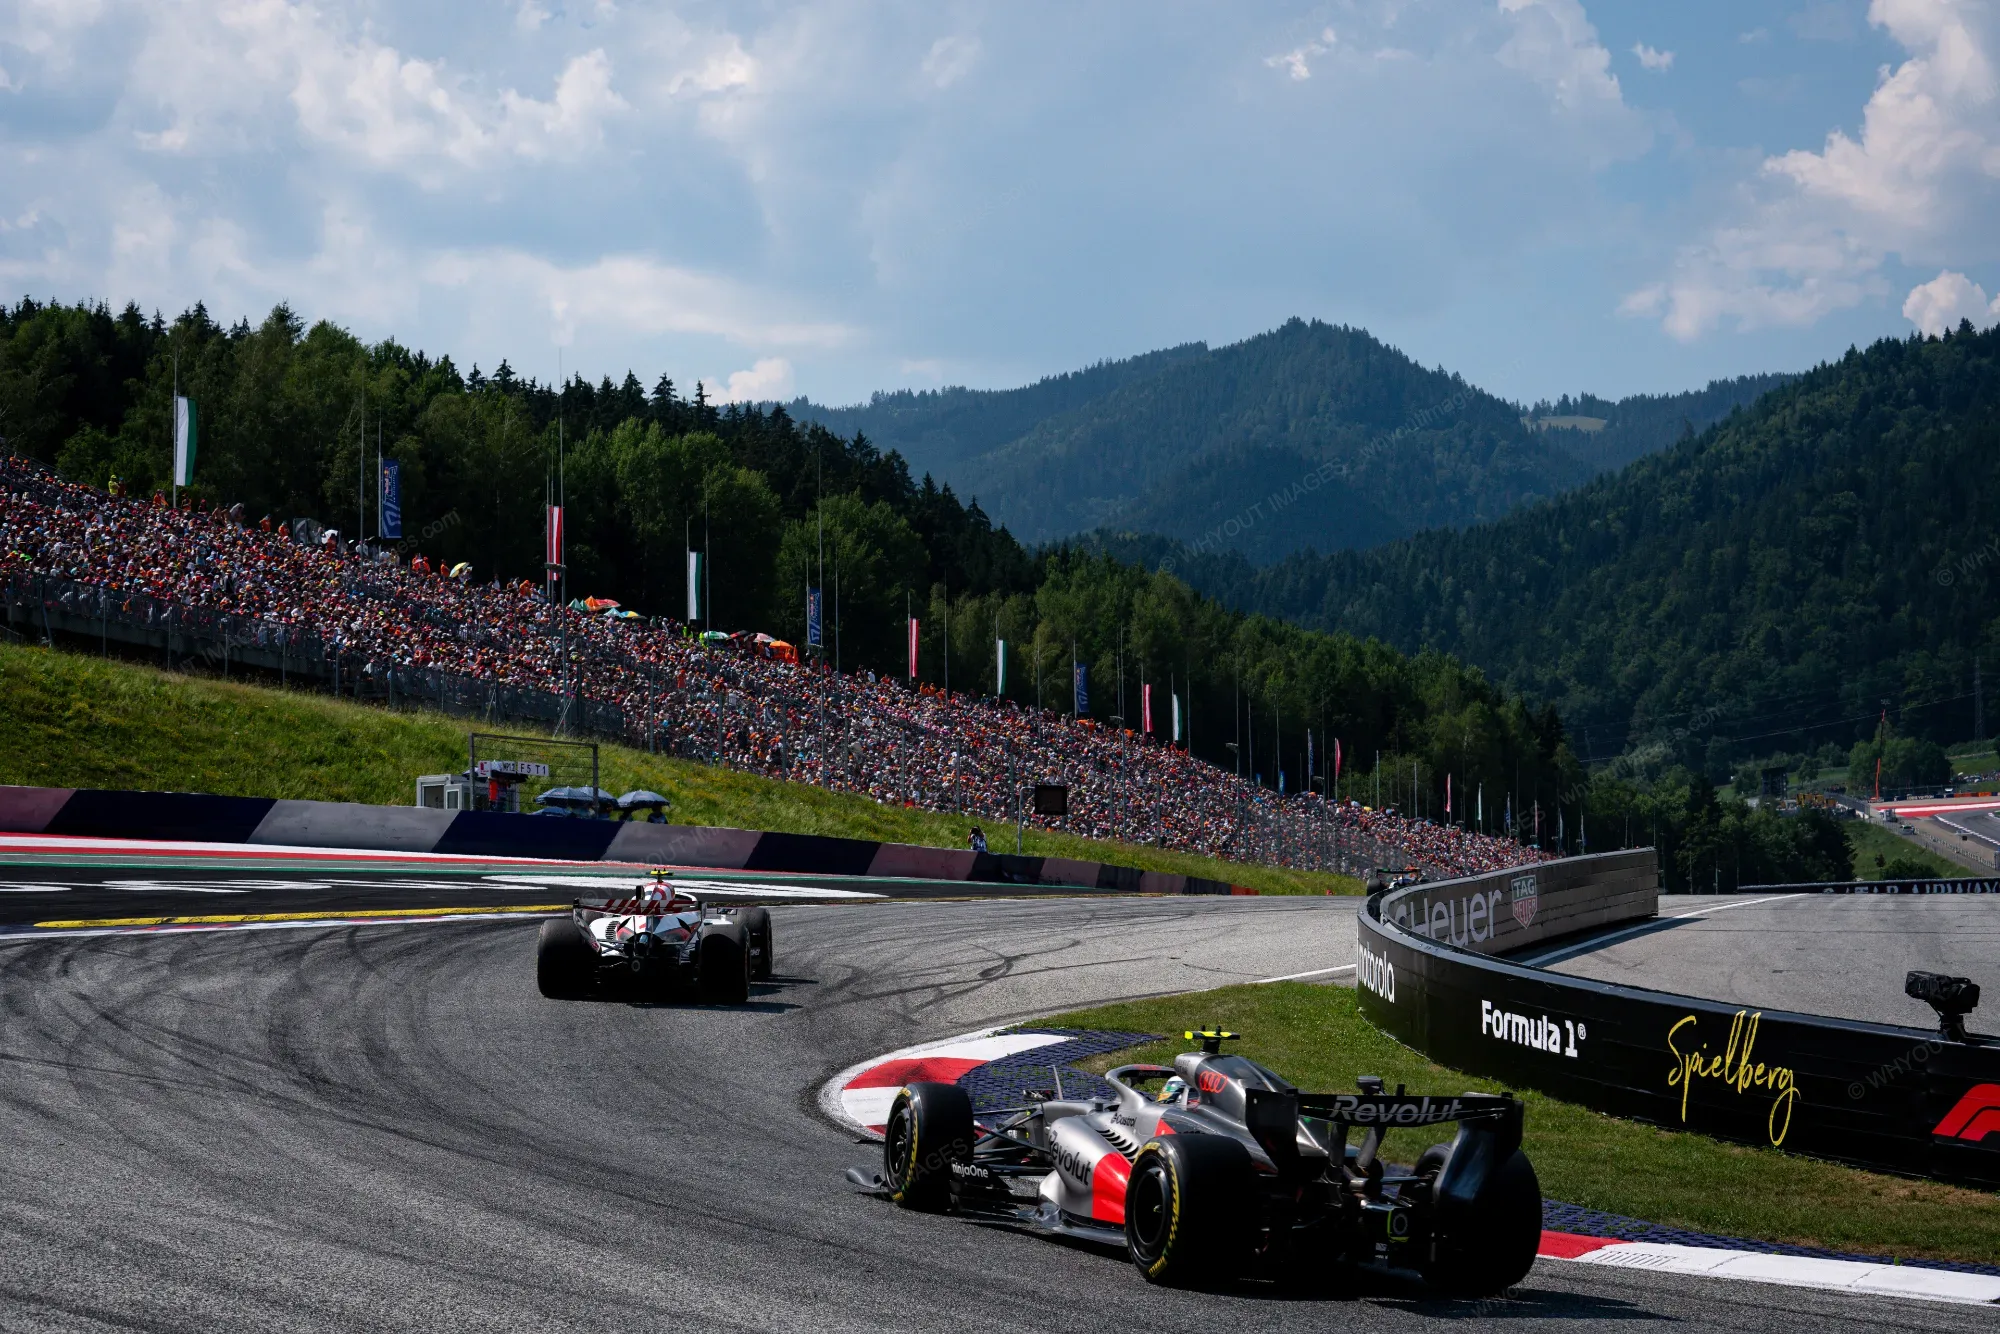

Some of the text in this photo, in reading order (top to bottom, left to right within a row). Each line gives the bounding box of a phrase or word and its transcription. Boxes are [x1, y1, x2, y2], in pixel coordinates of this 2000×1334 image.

[1514, 879, 1536, 898] TAG
[1514, 896, 1537, 921] HEUER
[1410, 889, 1503, 947] Heuer
[1357, 940, 1395, 1003] motorola
[1481, 999, 1561, 1054] Formula
[1667, 1009, 1802, 1147] Spielberg
[1329, 1095, 1465, 1124] Revolut
[1048, 1130, 1092, 1186] Revolut
